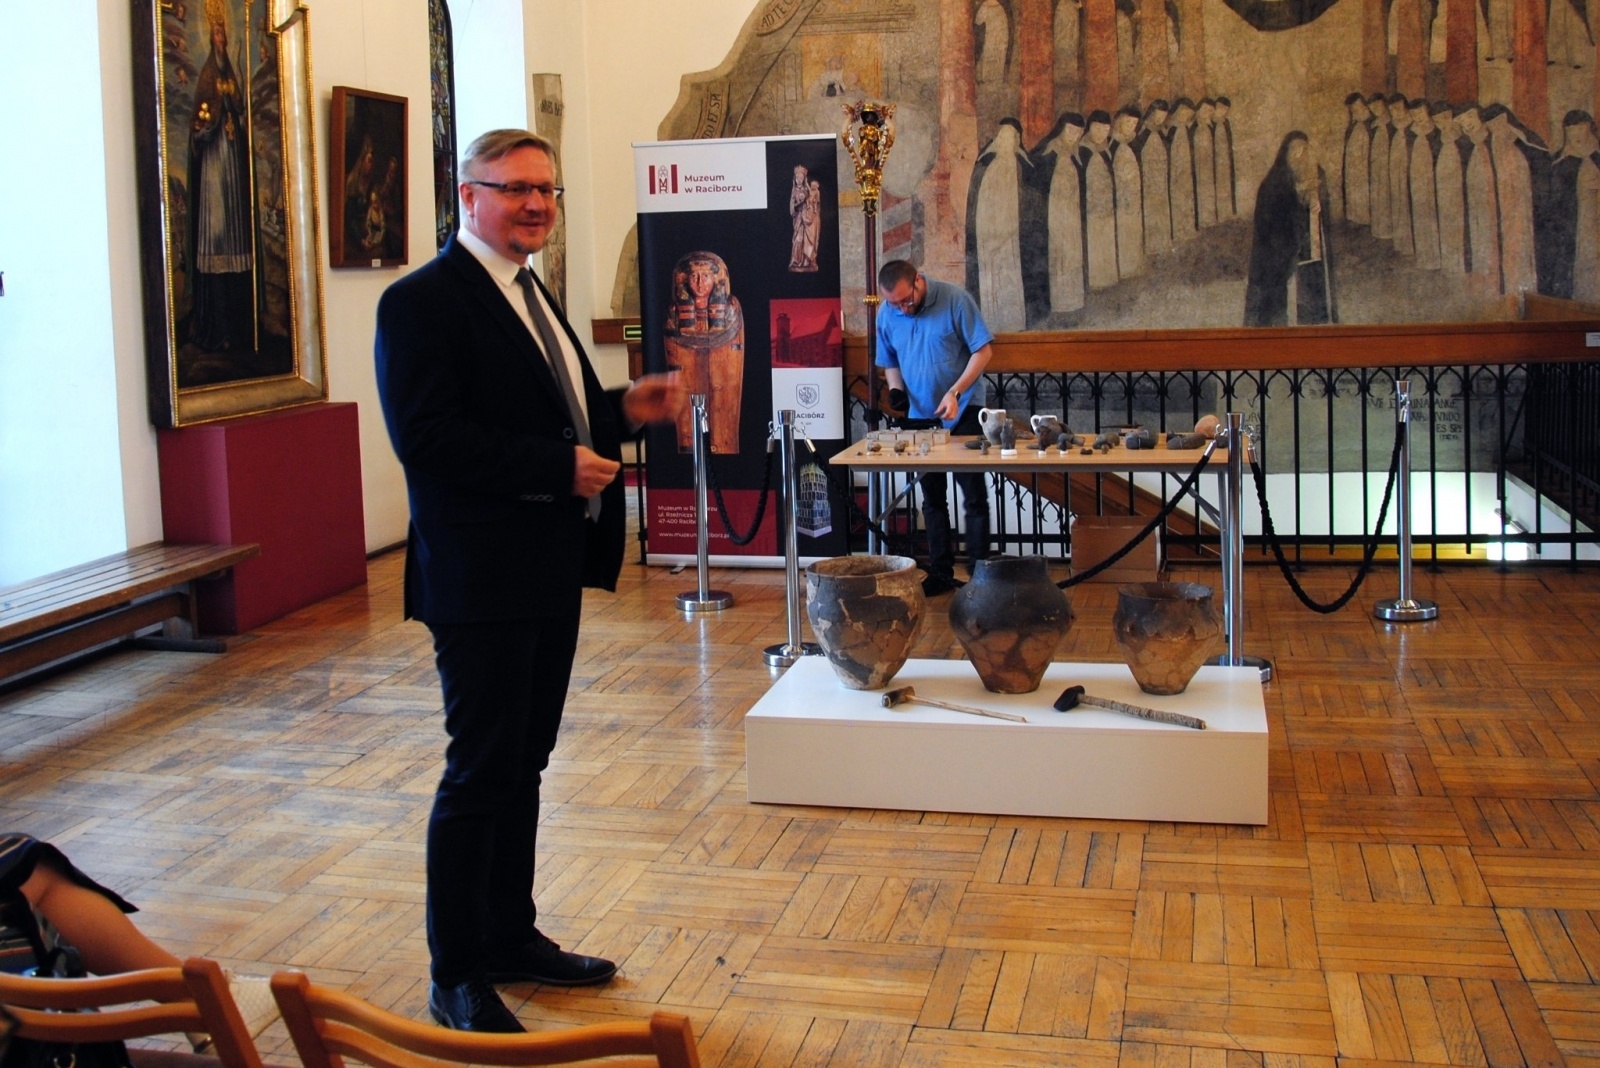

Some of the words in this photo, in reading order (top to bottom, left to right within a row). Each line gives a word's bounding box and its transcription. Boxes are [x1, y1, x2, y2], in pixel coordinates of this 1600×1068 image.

[684, 174, 725, 182] Muzeum
[695, 184, 743, 193] Raciborzu
[794, 411, 825, 419] ACIBÓRZ
